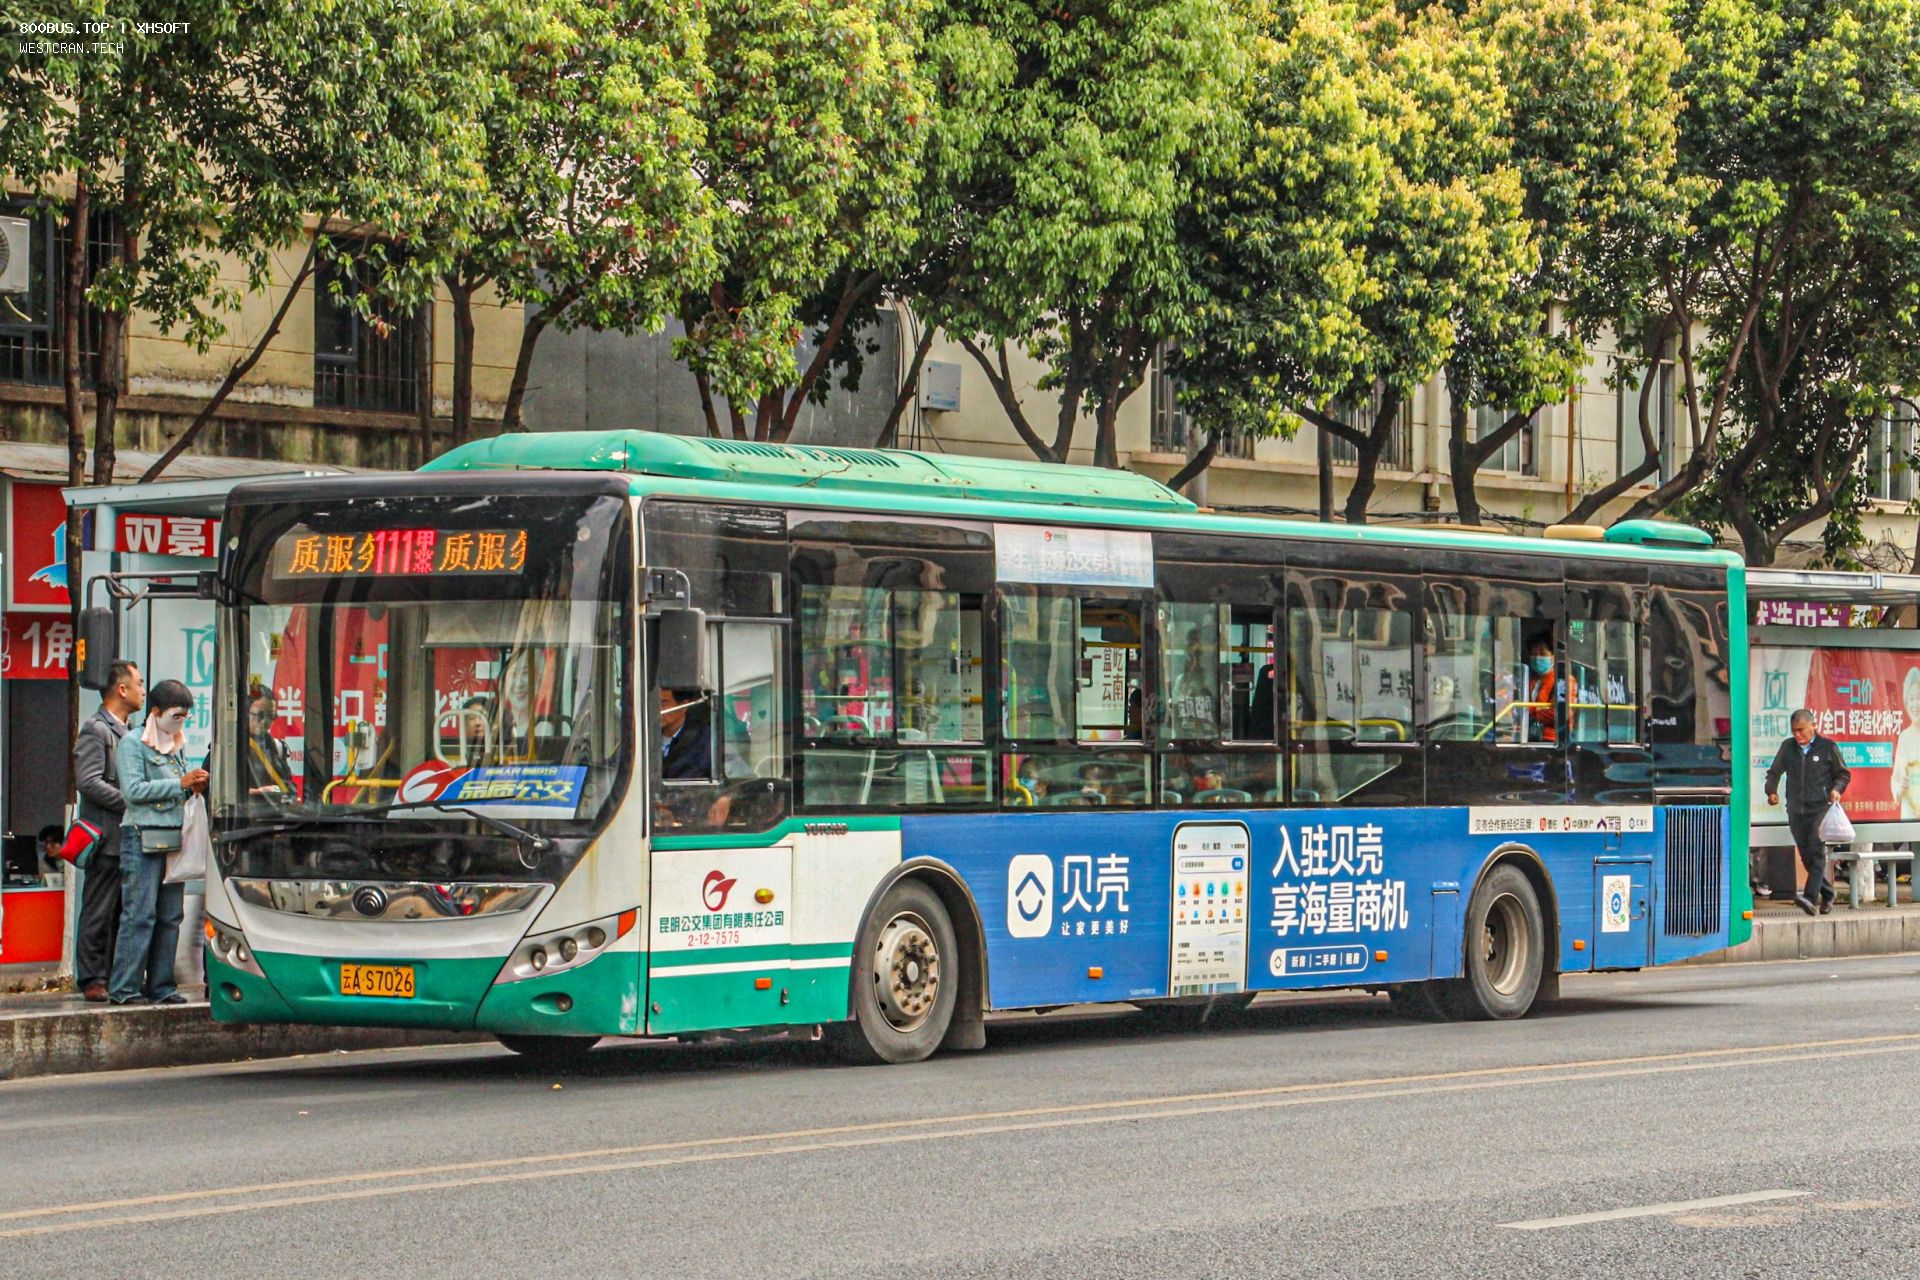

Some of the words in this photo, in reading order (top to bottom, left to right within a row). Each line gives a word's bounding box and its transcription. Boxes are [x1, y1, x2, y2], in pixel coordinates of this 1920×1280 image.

[1102, 674, 1124, 702] 云南
[1836, 678, 1873, 705] 一口价
[1751, 713, 1793, 737] 德韩口
[1848, 708, 1903, 736] 舒适化种牙
[457, 779, 575, 803] 品质公交
[1272, 823, 1384, 879] 入驻贝壳
[1062, 853, 1130, 914] 贝壳
[1271, 878, 1409, 937] 享海量商机
[659, 910, 785, 934] 昆明公交集团有限责任公司
[1061, 919, 1129, 937] 让家更美好
[687, 930, 741, 947] 2-12-7575
